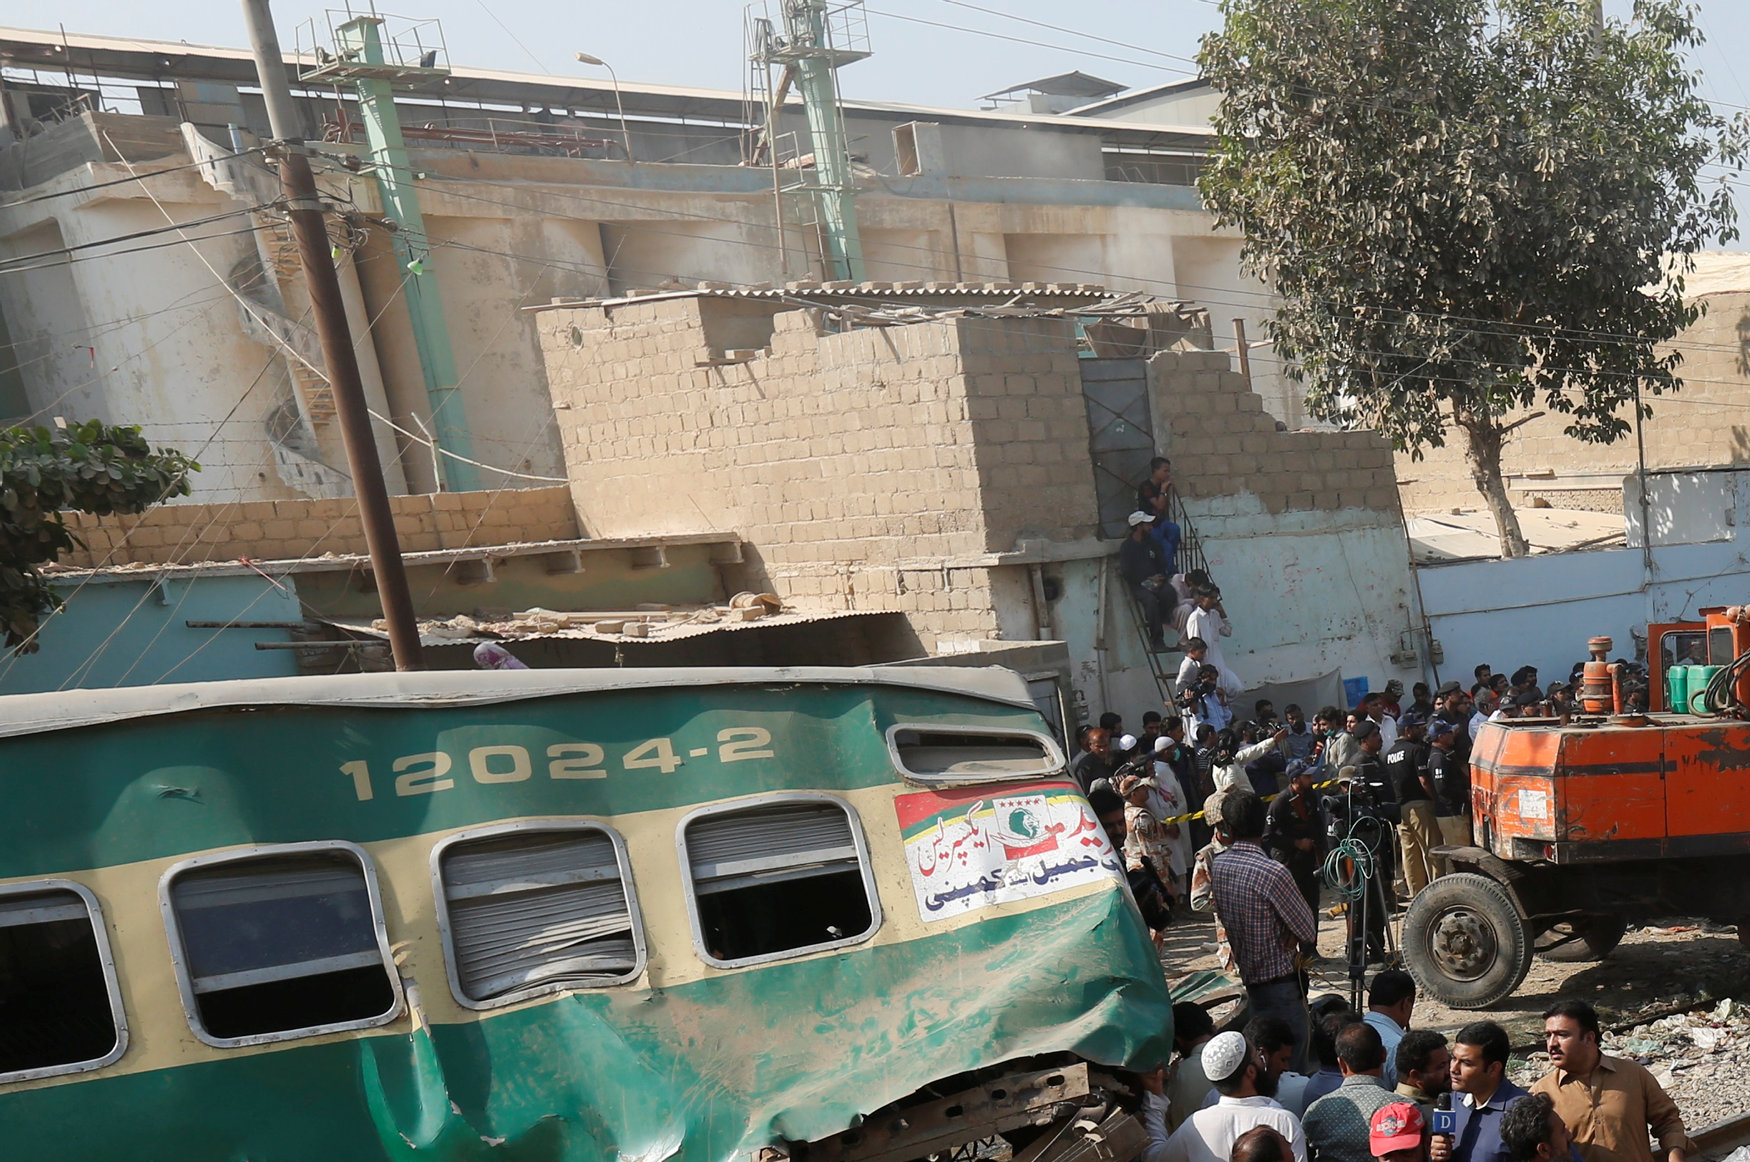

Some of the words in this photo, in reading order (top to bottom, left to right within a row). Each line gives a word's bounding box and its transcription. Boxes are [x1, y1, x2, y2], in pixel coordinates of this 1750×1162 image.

[339, 727, 775, 801] 12024-2
[1387, 750, 1405, 765] POLICE
[925, 868, 1006, 912] کمپنی
[1441, 1115, 1451, 1129] D
